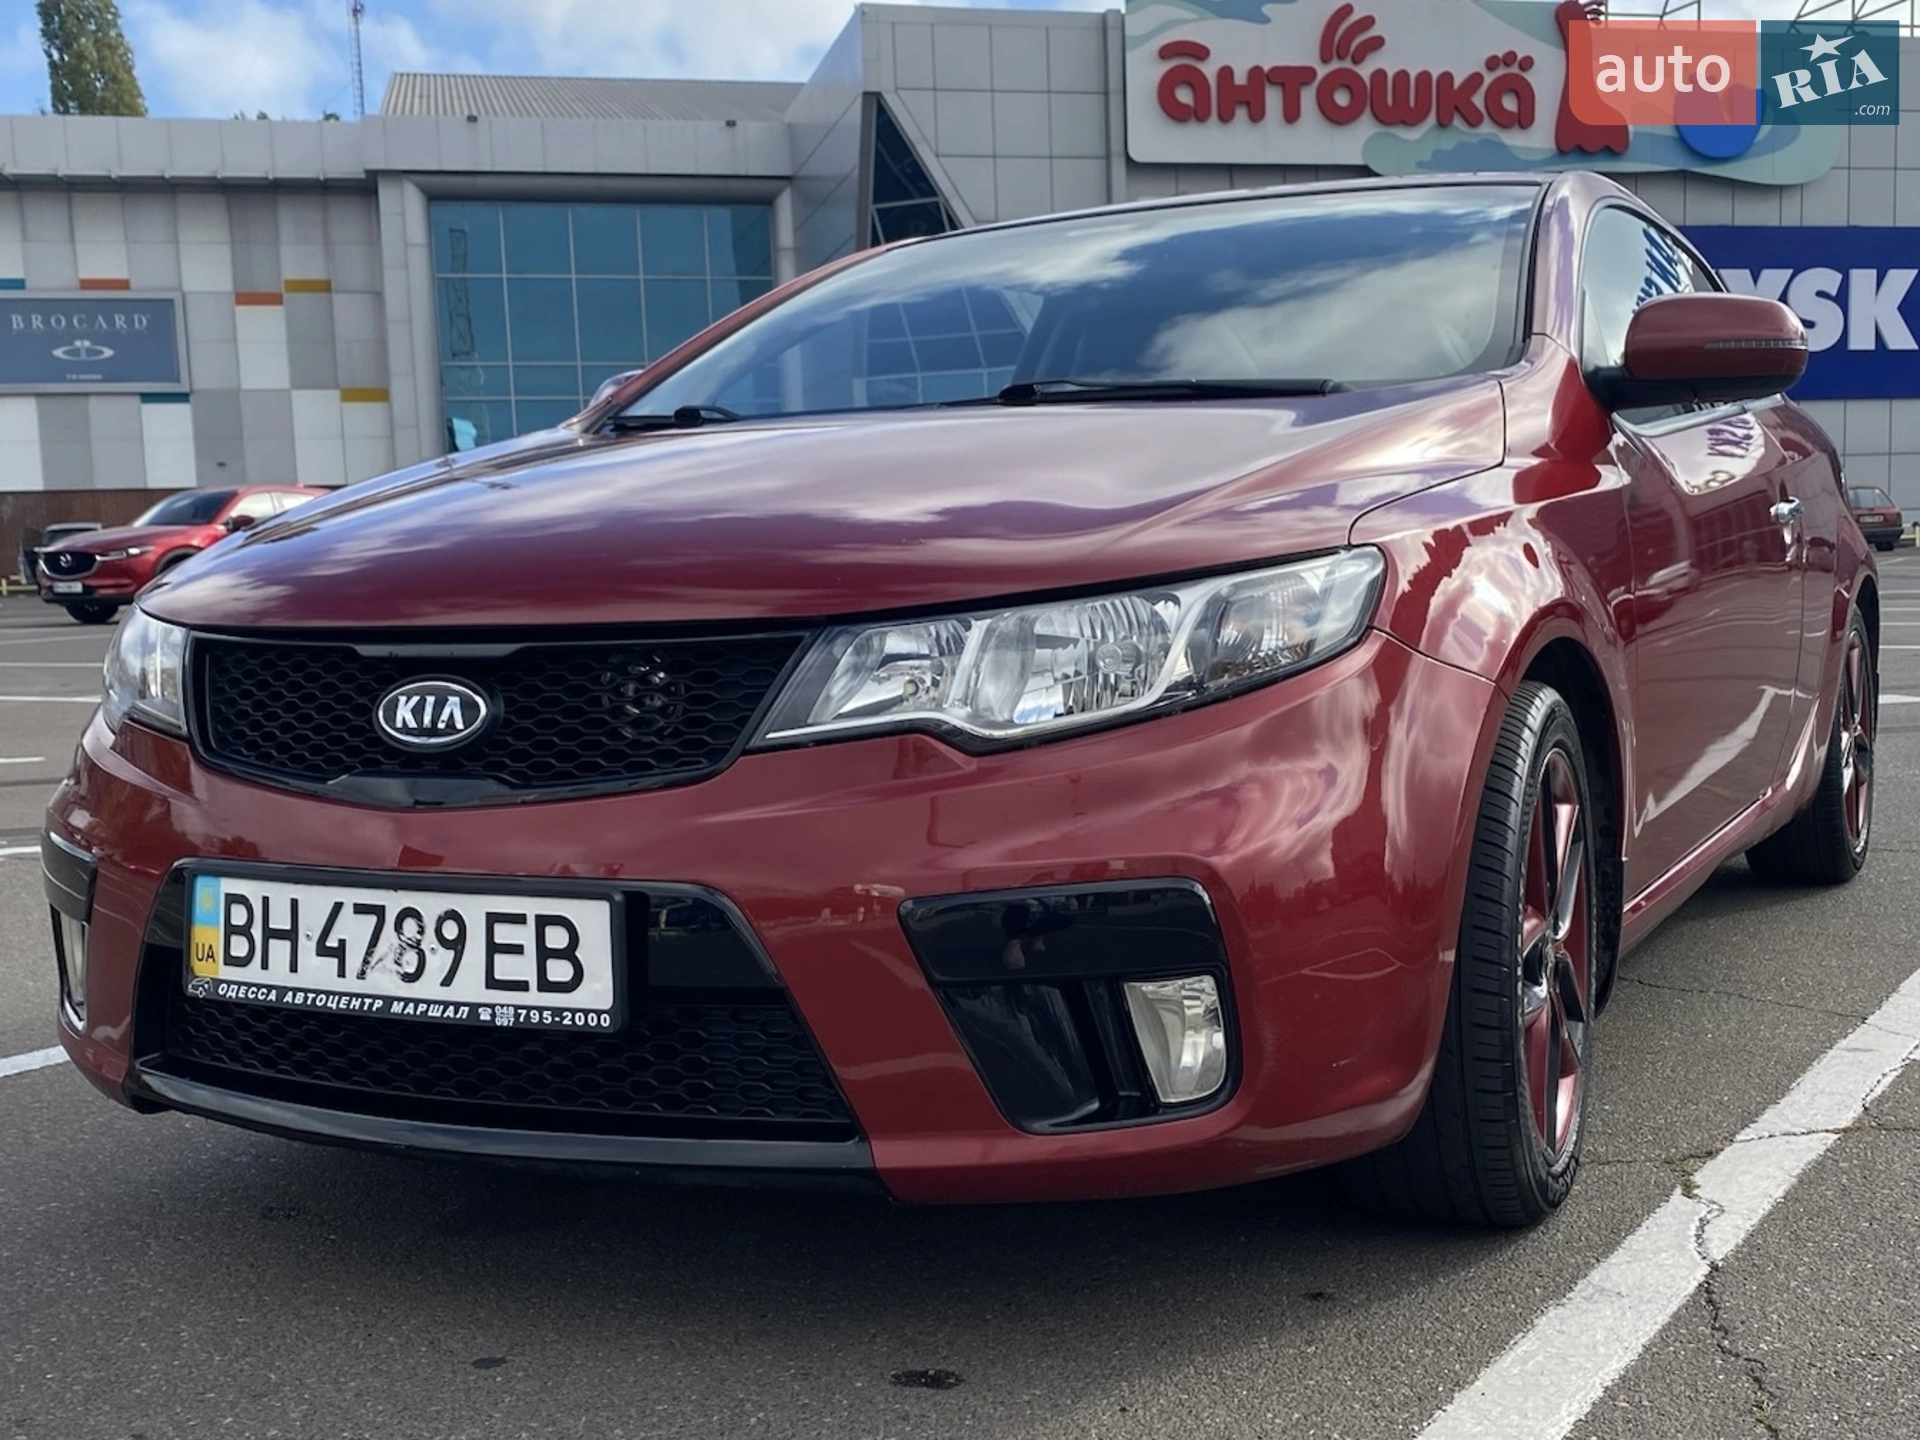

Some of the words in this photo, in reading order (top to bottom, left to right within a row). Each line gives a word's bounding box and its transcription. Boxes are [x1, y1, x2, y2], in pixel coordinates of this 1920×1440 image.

[11, 313, 148, 330] BROCARD
[395, 695, 465, 730] KIA
[195, 942, 217, 963] UA
[223, 892, 299, 974] BH
[315, 901, 467, 988] 4789
[485, 911, 585, 994] EB
[217, 983, 278, 1002] ОДЕССА
[283, 990, 384, 1012] АВТОЦЕНТР
[389, 1001, 471, 1020] МАРШАЛ
[517, 1009, 611, 1027] 795-2000
